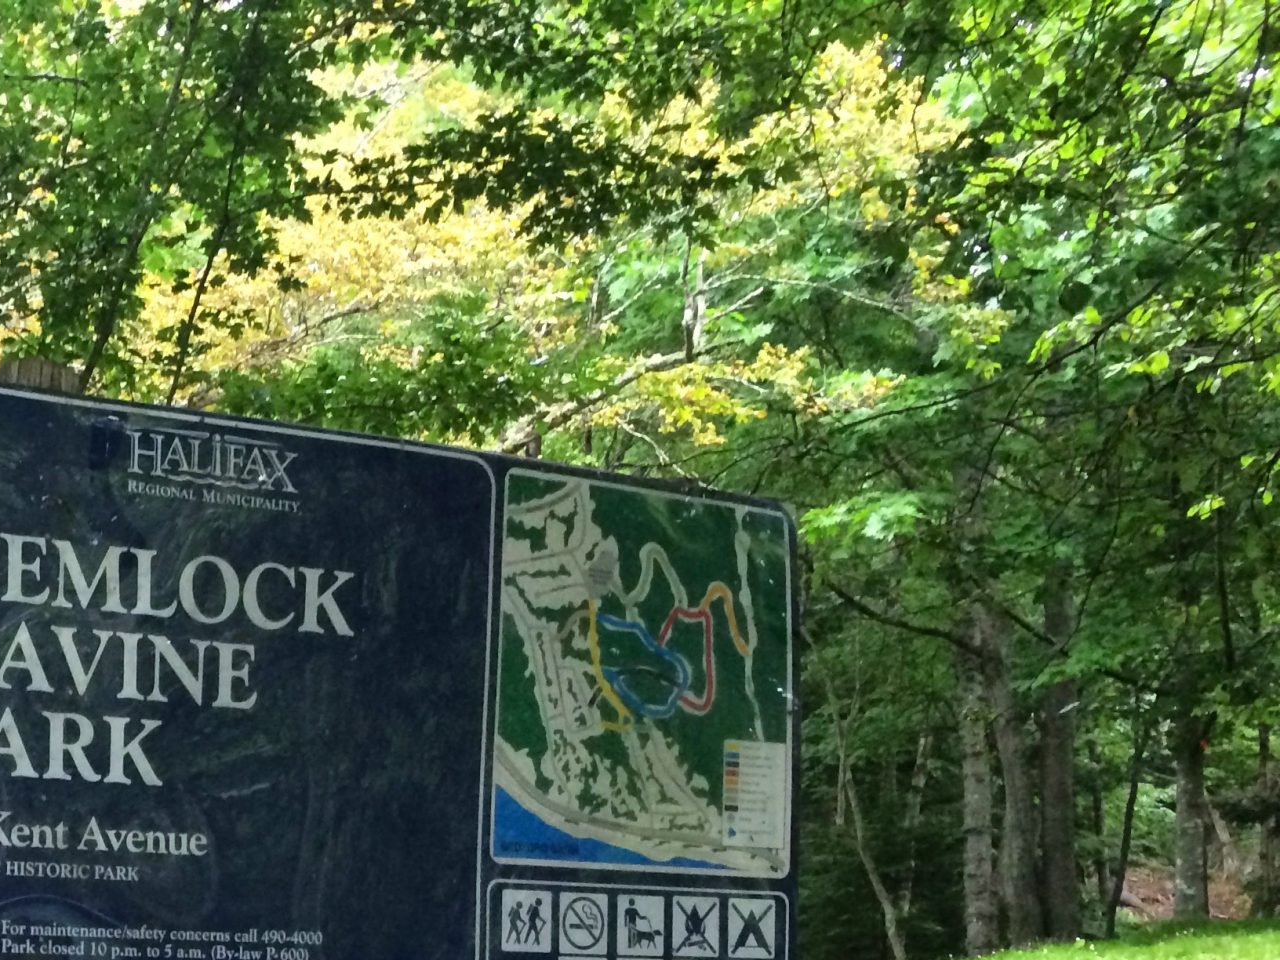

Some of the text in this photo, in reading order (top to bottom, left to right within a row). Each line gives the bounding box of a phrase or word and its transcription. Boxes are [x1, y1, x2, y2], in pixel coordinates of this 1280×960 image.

[126, 430, 299, 493] HALIFAX
[127, 480, 301, 512] REGIONAL MUNICIPALITY
[78, 816, 209, 857] Avenue
[5, 862, 90, 880] HISTORIC
[93, 865, 139, 882] PARK
[1, 919, 323, 945] For maintenance/safety concerns call 490-4000
[1, 938, 35, 954] Park
[39, 940, 84, 956] closed
[90, 941, 107, 957] 10
[111, 945, 142, 959] p.m.
[146, 943, 161, 958] to
[164, 943, 173, 958] 5
[176, 947, 206, 959] a.m.
